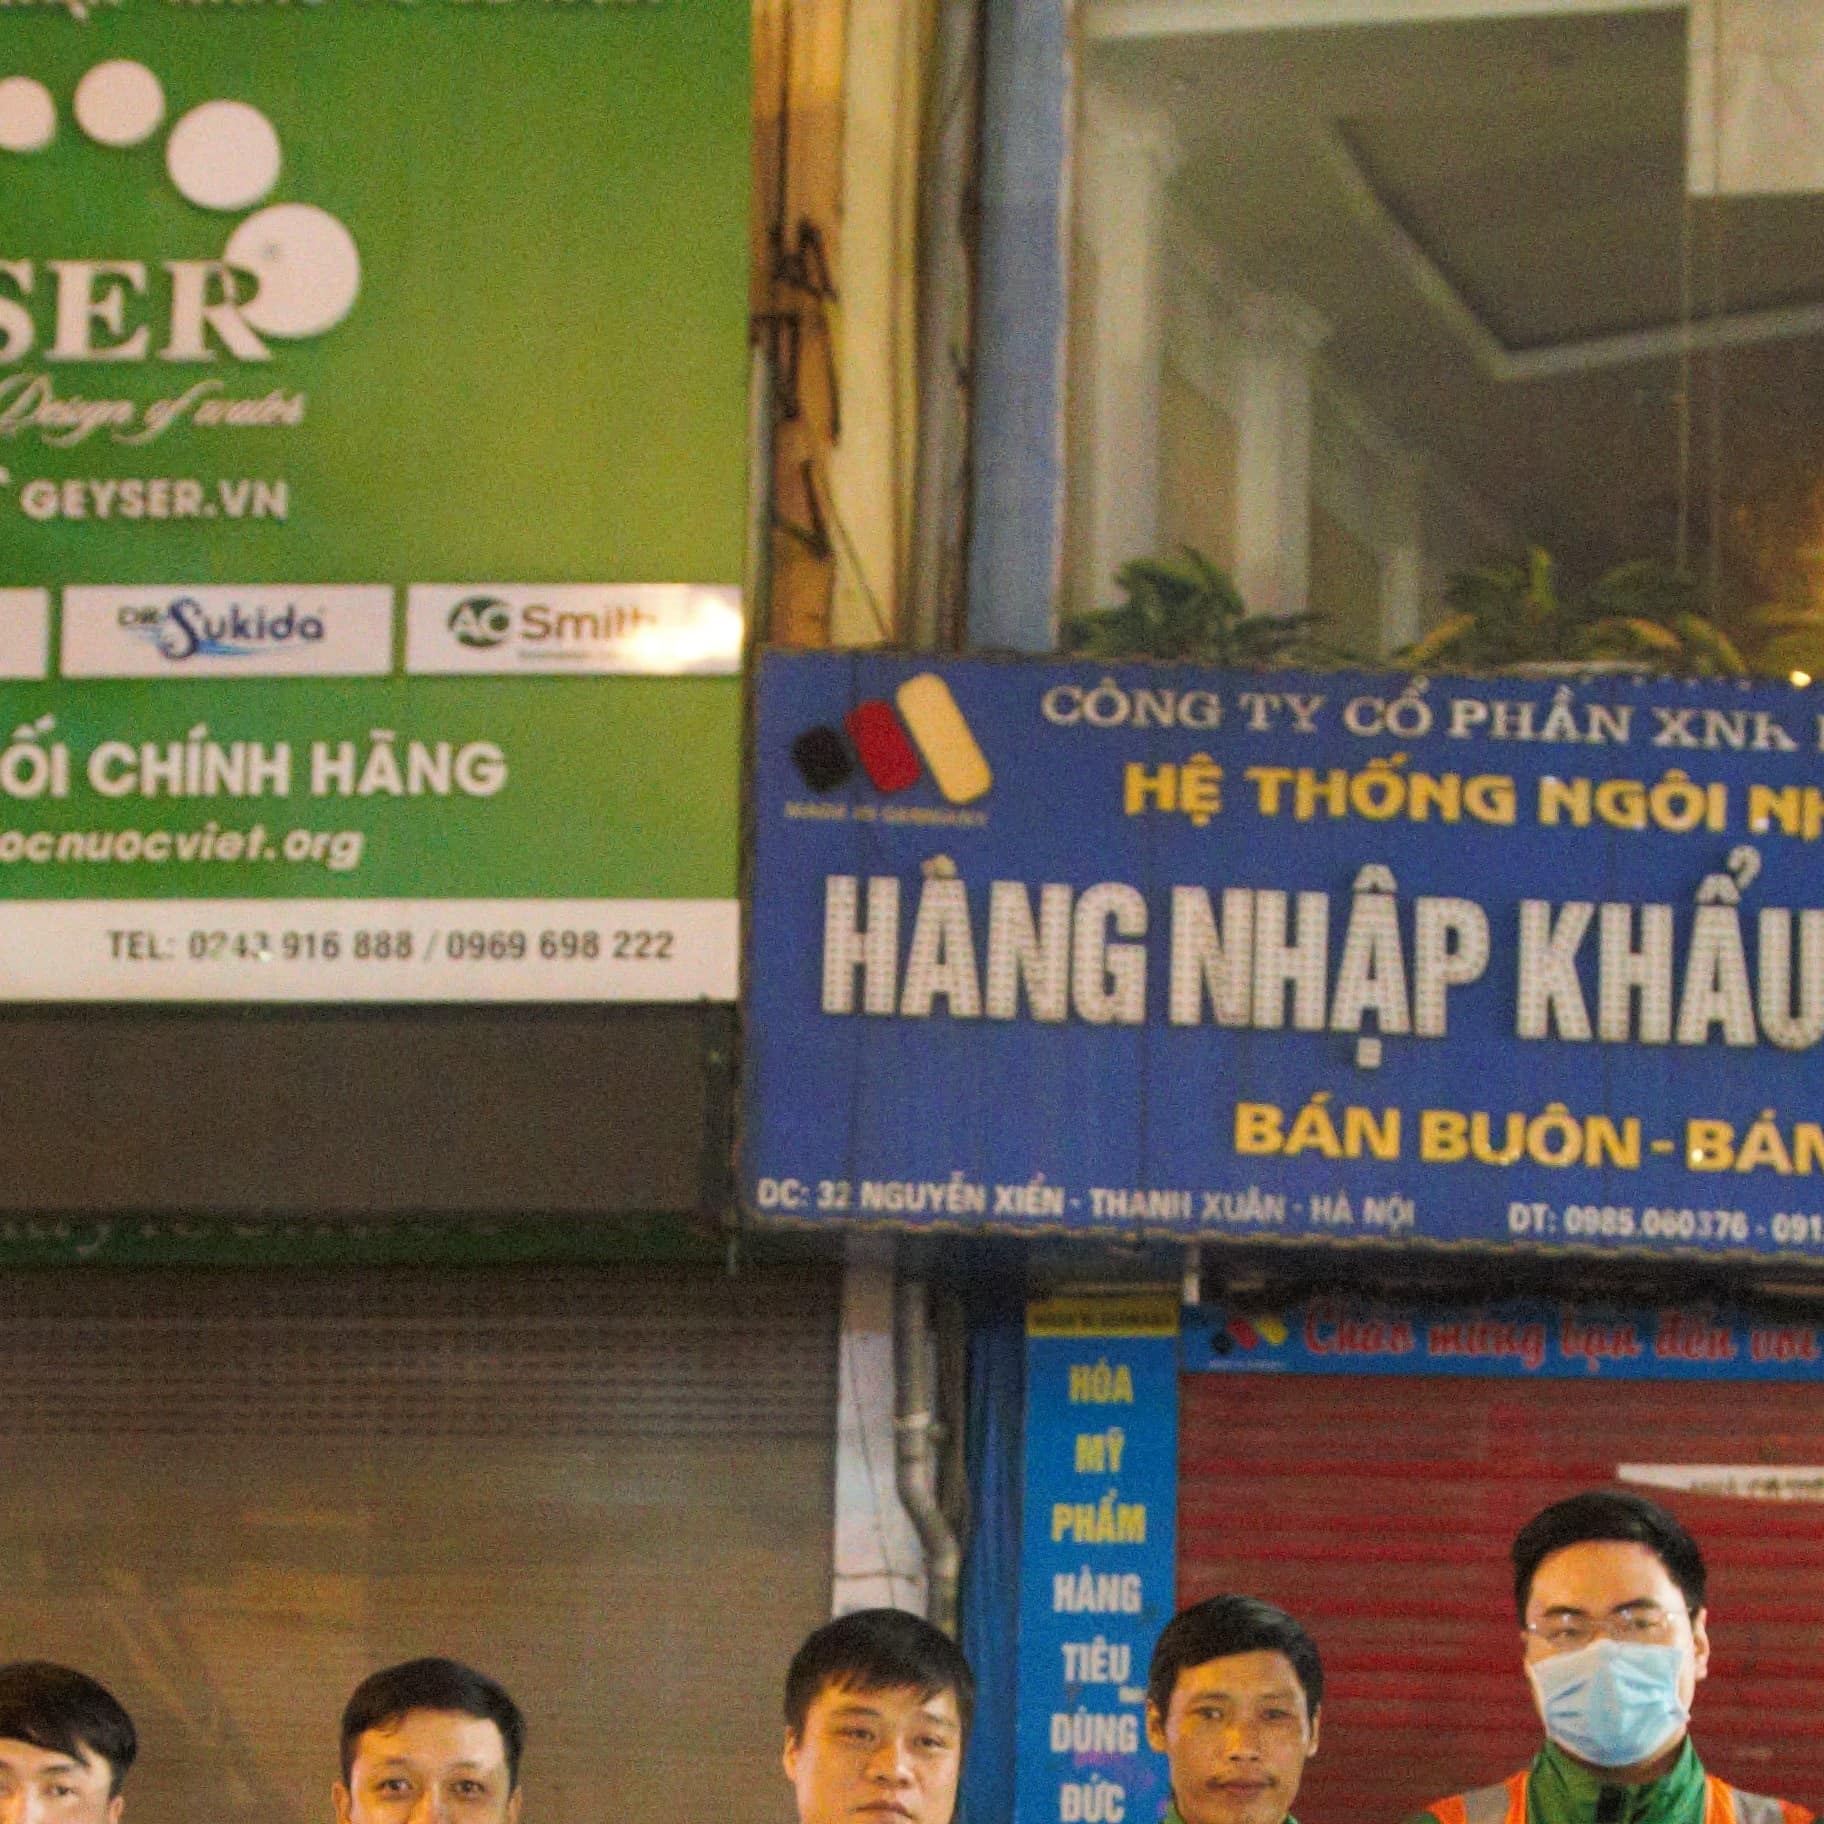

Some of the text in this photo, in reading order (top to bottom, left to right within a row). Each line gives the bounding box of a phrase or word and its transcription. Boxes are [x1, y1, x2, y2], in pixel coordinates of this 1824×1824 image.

[21, 478, 289, 522] GEYSER.VN
[1042, 677, 1221, 730] CÔNG
[1240, 692, 1326, 733] TY
[1344, 674, 1432, 738] CỔ
[1448, 688, 1629, 746] PHẦN
[88, 723, 290, 798] CHÍNH
[1124, 753, 1224, 826] HỆ
[1244, 752, 1516, 828] THỐNG
[1538, 769, 1725, 832] NGÔI
[105, 929, 174, 961] TEL:
[282, 931, 342, 961] 916
[354, 931, 415, 961] 888
[446, 930, 527, 961] 0969
[538, 930, 602, 960] 698
[612, 930, 675, 960] 222
[821, 853, 1149, 1025] HÀNG
[1169, 864, 1490, 1069] NHẬP
[1234, 1092, 1401, 1161] BÁN
[1420, 1102, 1641, 1169] BUÔN
[817, 1180, 850, 1211] 32
[1088, 1187, 1192, 1221] THANH
[1076, 1427, 1125, 1473] MỸ
[1051, 1489, 1146, 1543] PHẨM
[1061, 1635, 1131, 1683] TIÊU
